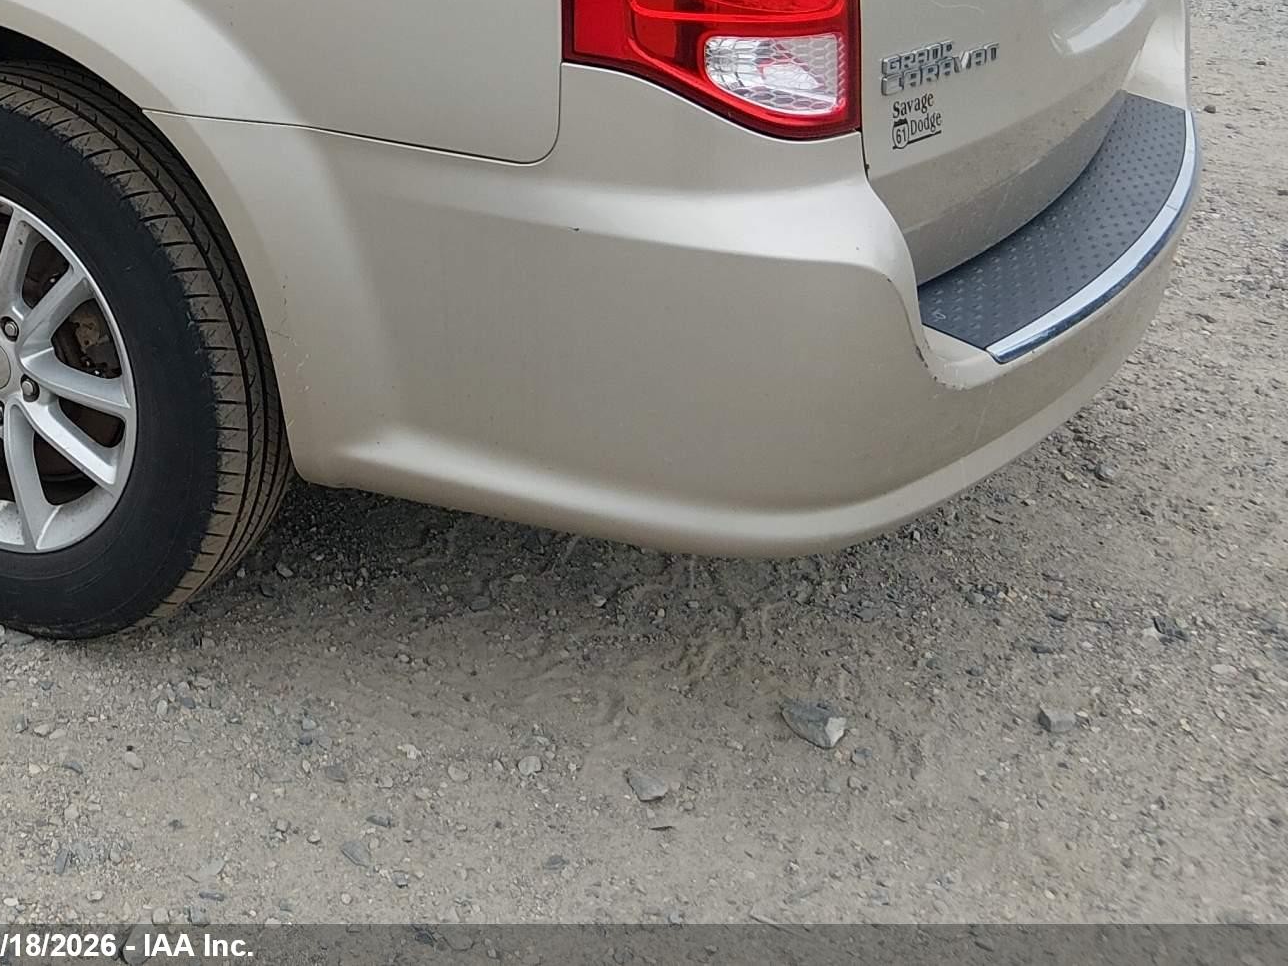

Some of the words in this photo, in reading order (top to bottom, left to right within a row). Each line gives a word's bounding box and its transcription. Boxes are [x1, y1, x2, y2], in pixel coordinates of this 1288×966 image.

[881, 43, 999, 96] CARAVAN
[892, 92, 934, 119] Savage
[895, 127, 907, 145] 61
[910, 111, 942, 136] Dodge
